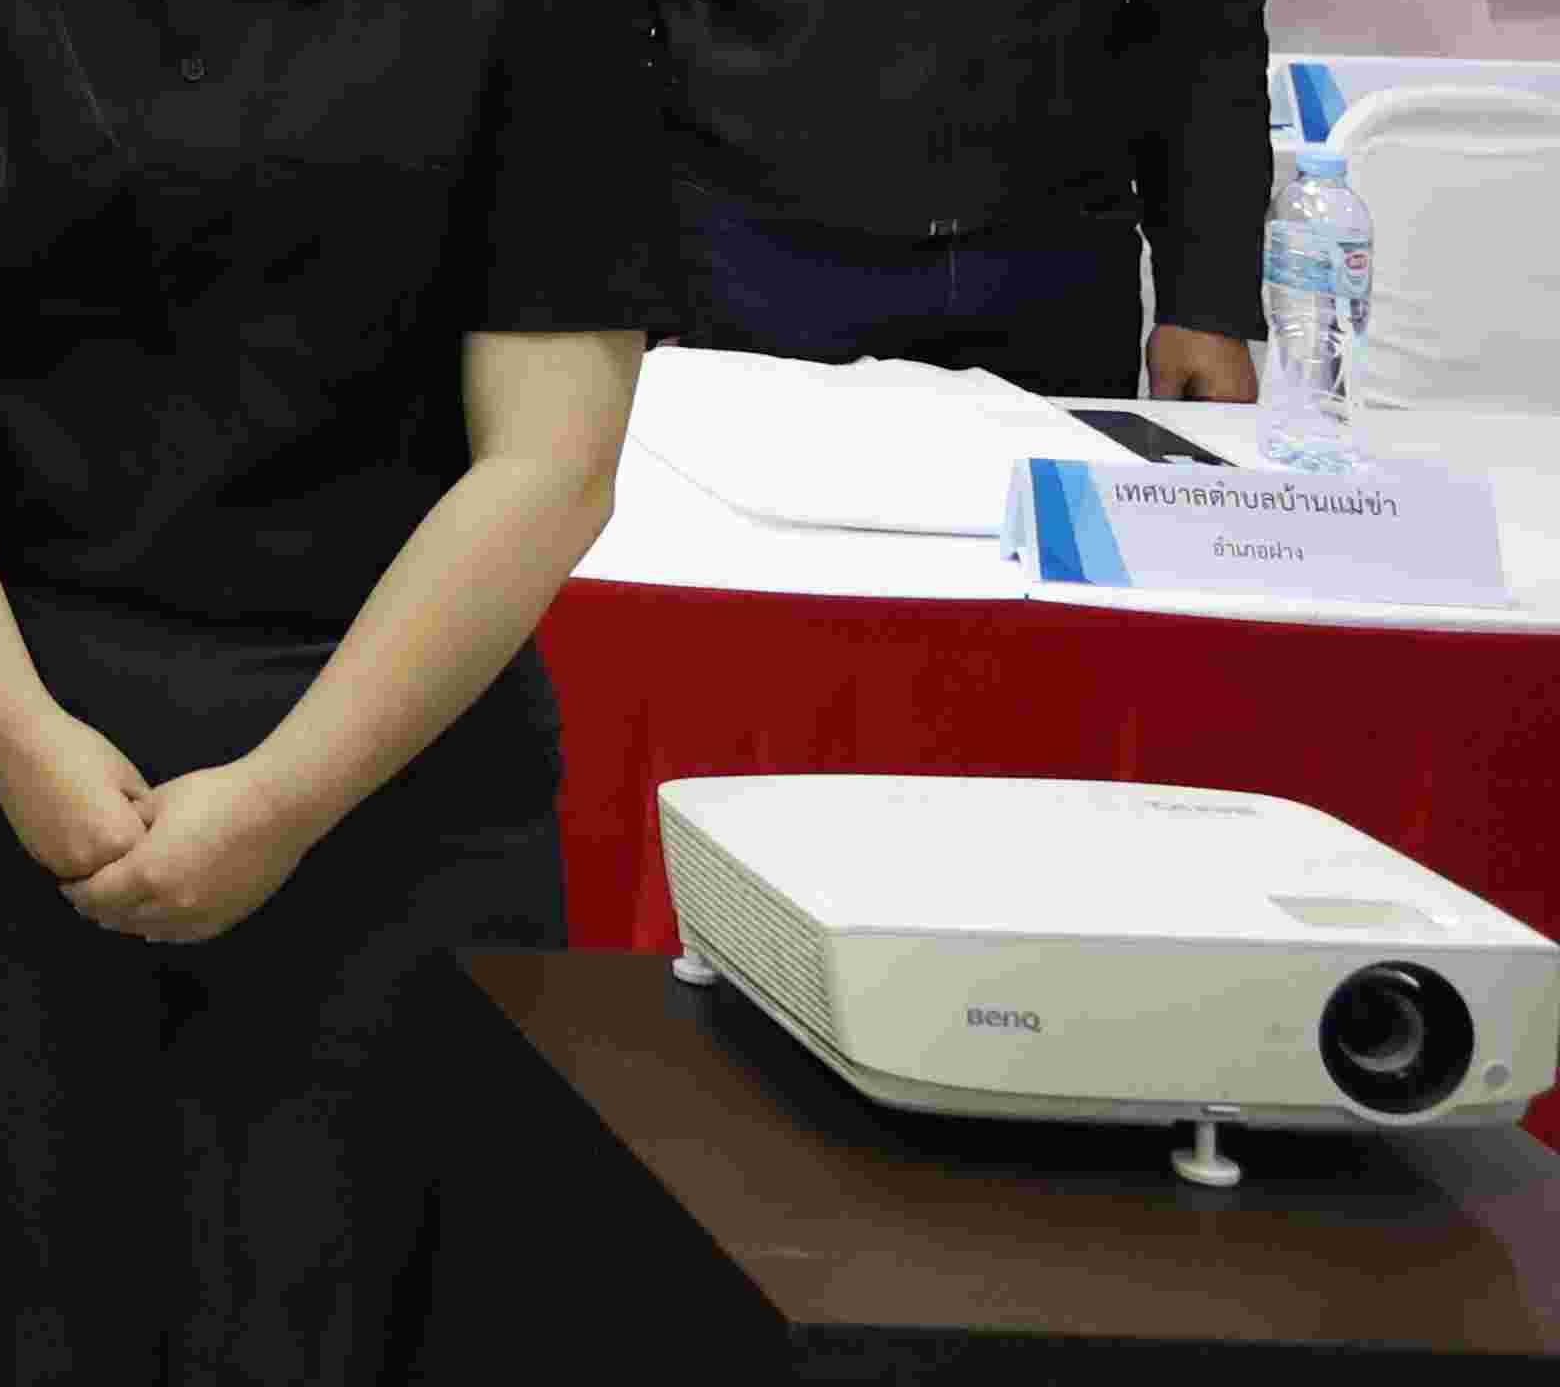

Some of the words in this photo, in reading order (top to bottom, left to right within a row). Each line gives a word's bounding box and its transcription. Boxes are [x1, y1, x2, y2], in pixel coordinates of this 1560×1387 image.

[1114, 480, 1399, 518] เทศบาลตำบลบ้านแม่ข่า
[1212, 536, 1305, 562] อำเภอฝาง
[967, 1007, 1041, 1034] BenQ
